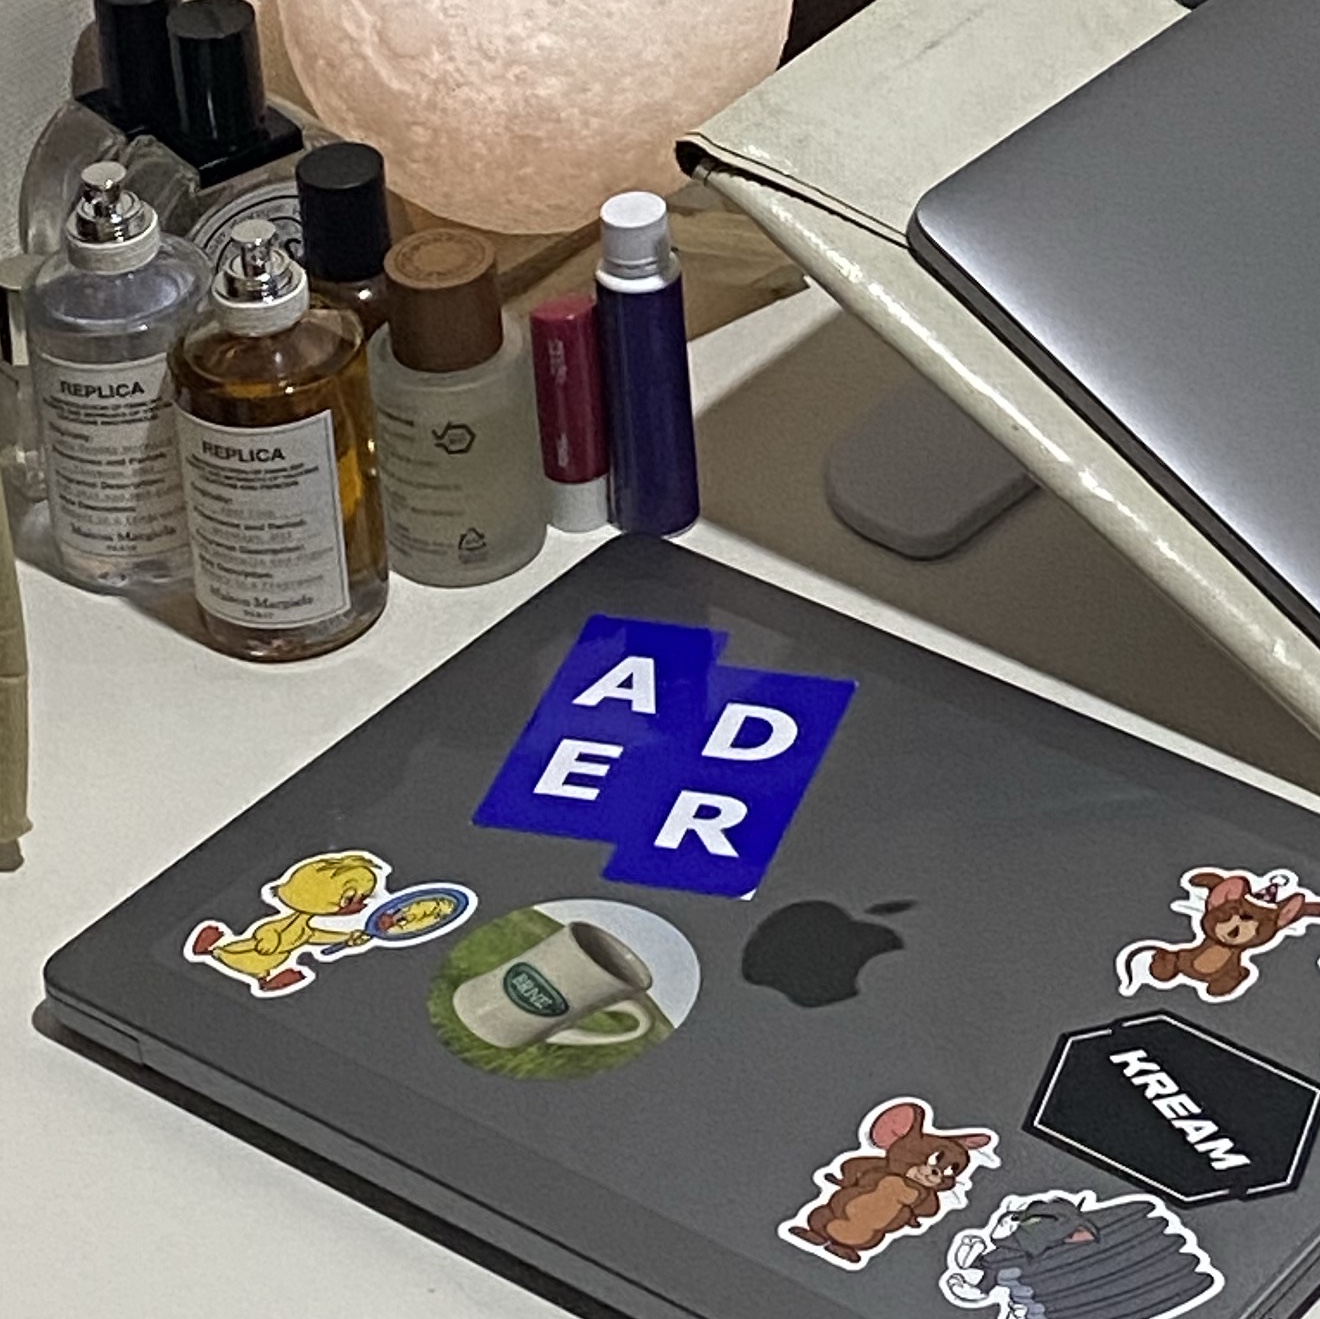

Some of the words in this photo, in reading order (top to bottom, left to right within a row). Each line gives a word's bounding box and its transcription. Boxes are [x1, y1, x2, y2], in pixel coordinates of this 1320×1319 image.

[60, 380, 145, 399] REPLICA
[202, 440, 286, 463] REPLICA
[1109, 1048, 1252, 1172] KREAM
